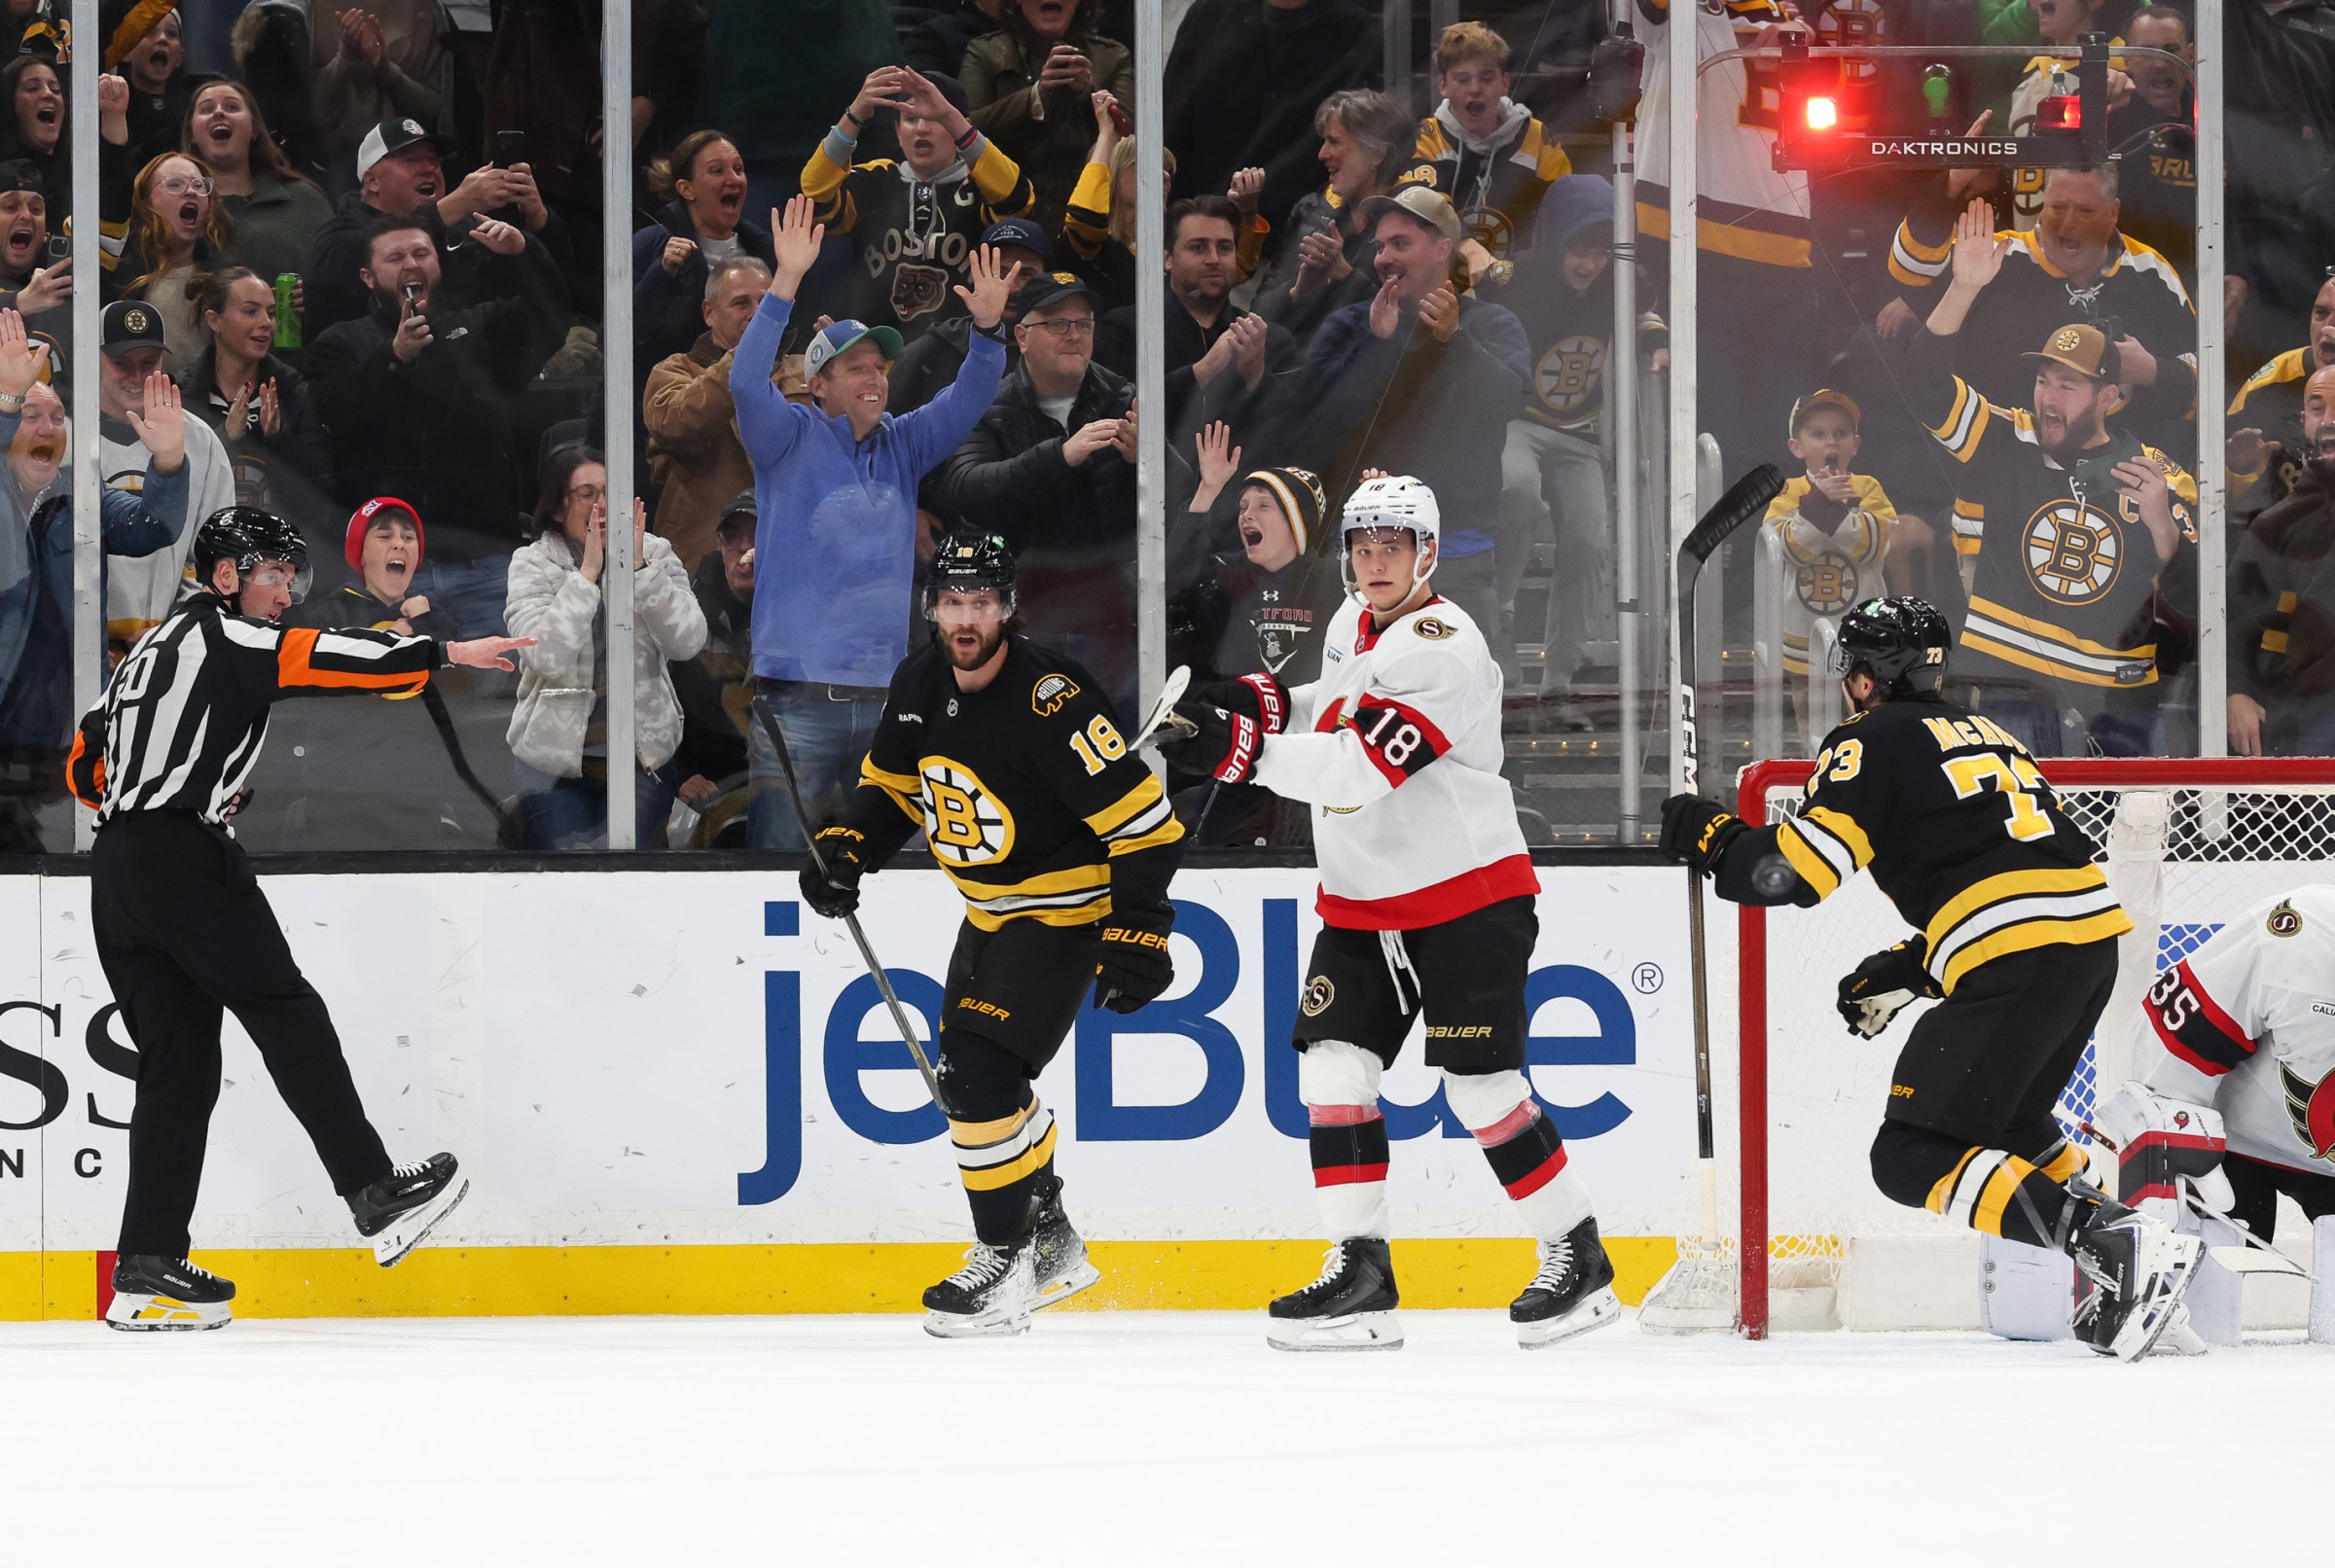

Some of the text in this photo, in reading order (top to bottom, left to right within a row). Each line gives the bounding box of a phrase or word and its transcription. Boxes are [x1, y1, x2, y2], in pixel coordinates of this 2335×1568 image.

[1872, 143, 2018, 155] DAKTRONICS
[1368, 483, 1386, 492] 18
[955, 547, 974, 558] 18
[2044, 517, 2101, 583] B
[1254, 607, 1312, 623] TFORD
[1421, 622, 1440, 637] S
[1926, 647, 1943, 664] 73
[1037, 677, 1065, 701] BRUINS
[1069, 714, 1127, 776] 18
[1364, 707, 1421, 766] 18
[929, 780, 983, 849] B
[1101, 927, 1168, 952] BAUER
[2149, 966, 2201, 1032] 35
[957, 997, 1011, 1022] AUER
[1426, 1025, 1493, 1038] BAUER
[162, 1273, 193, 1289] BAUER
